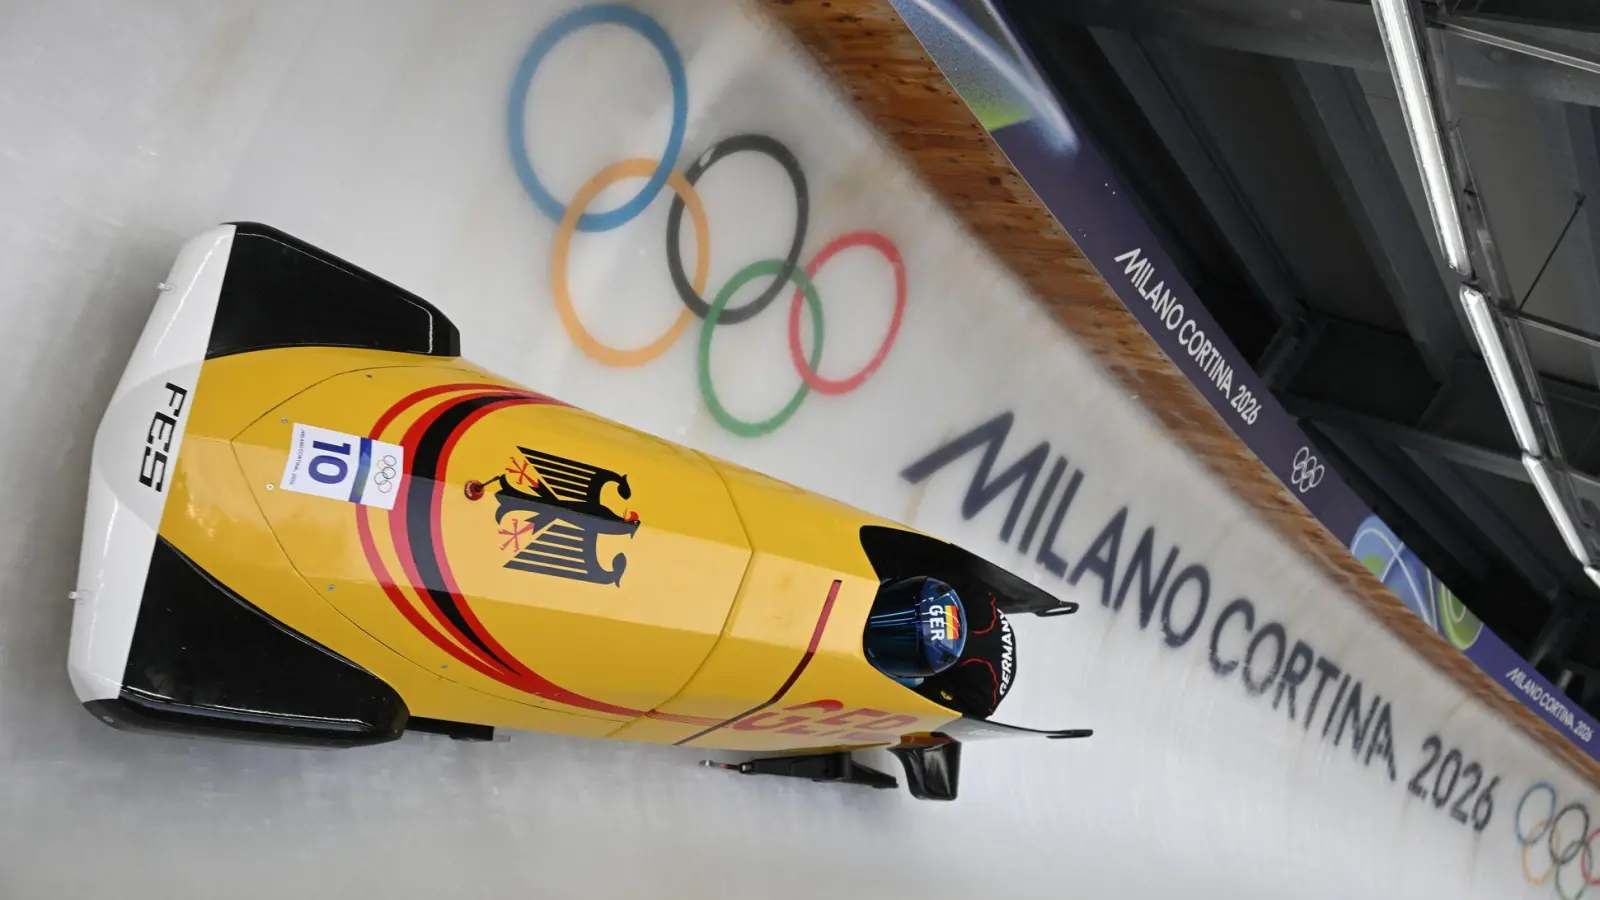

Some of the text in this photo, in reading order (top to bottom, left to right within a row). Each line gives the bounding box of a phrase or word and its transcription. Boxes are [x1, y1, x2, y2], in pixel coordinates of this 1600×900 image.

[1114, 248, 1262, 426] MILANO CORTINA 2026
[139, 382, 187, 493] FES
[308, 441, 351, 484] 10
[898, 411, 1503, 833] MILANO CORTINA 2026
[929, 605, 945, 641] GER
[996, 607, 1013, 696] GERMANY
[1505, 668, 1594, 742] MILANO CORTINA 2026
